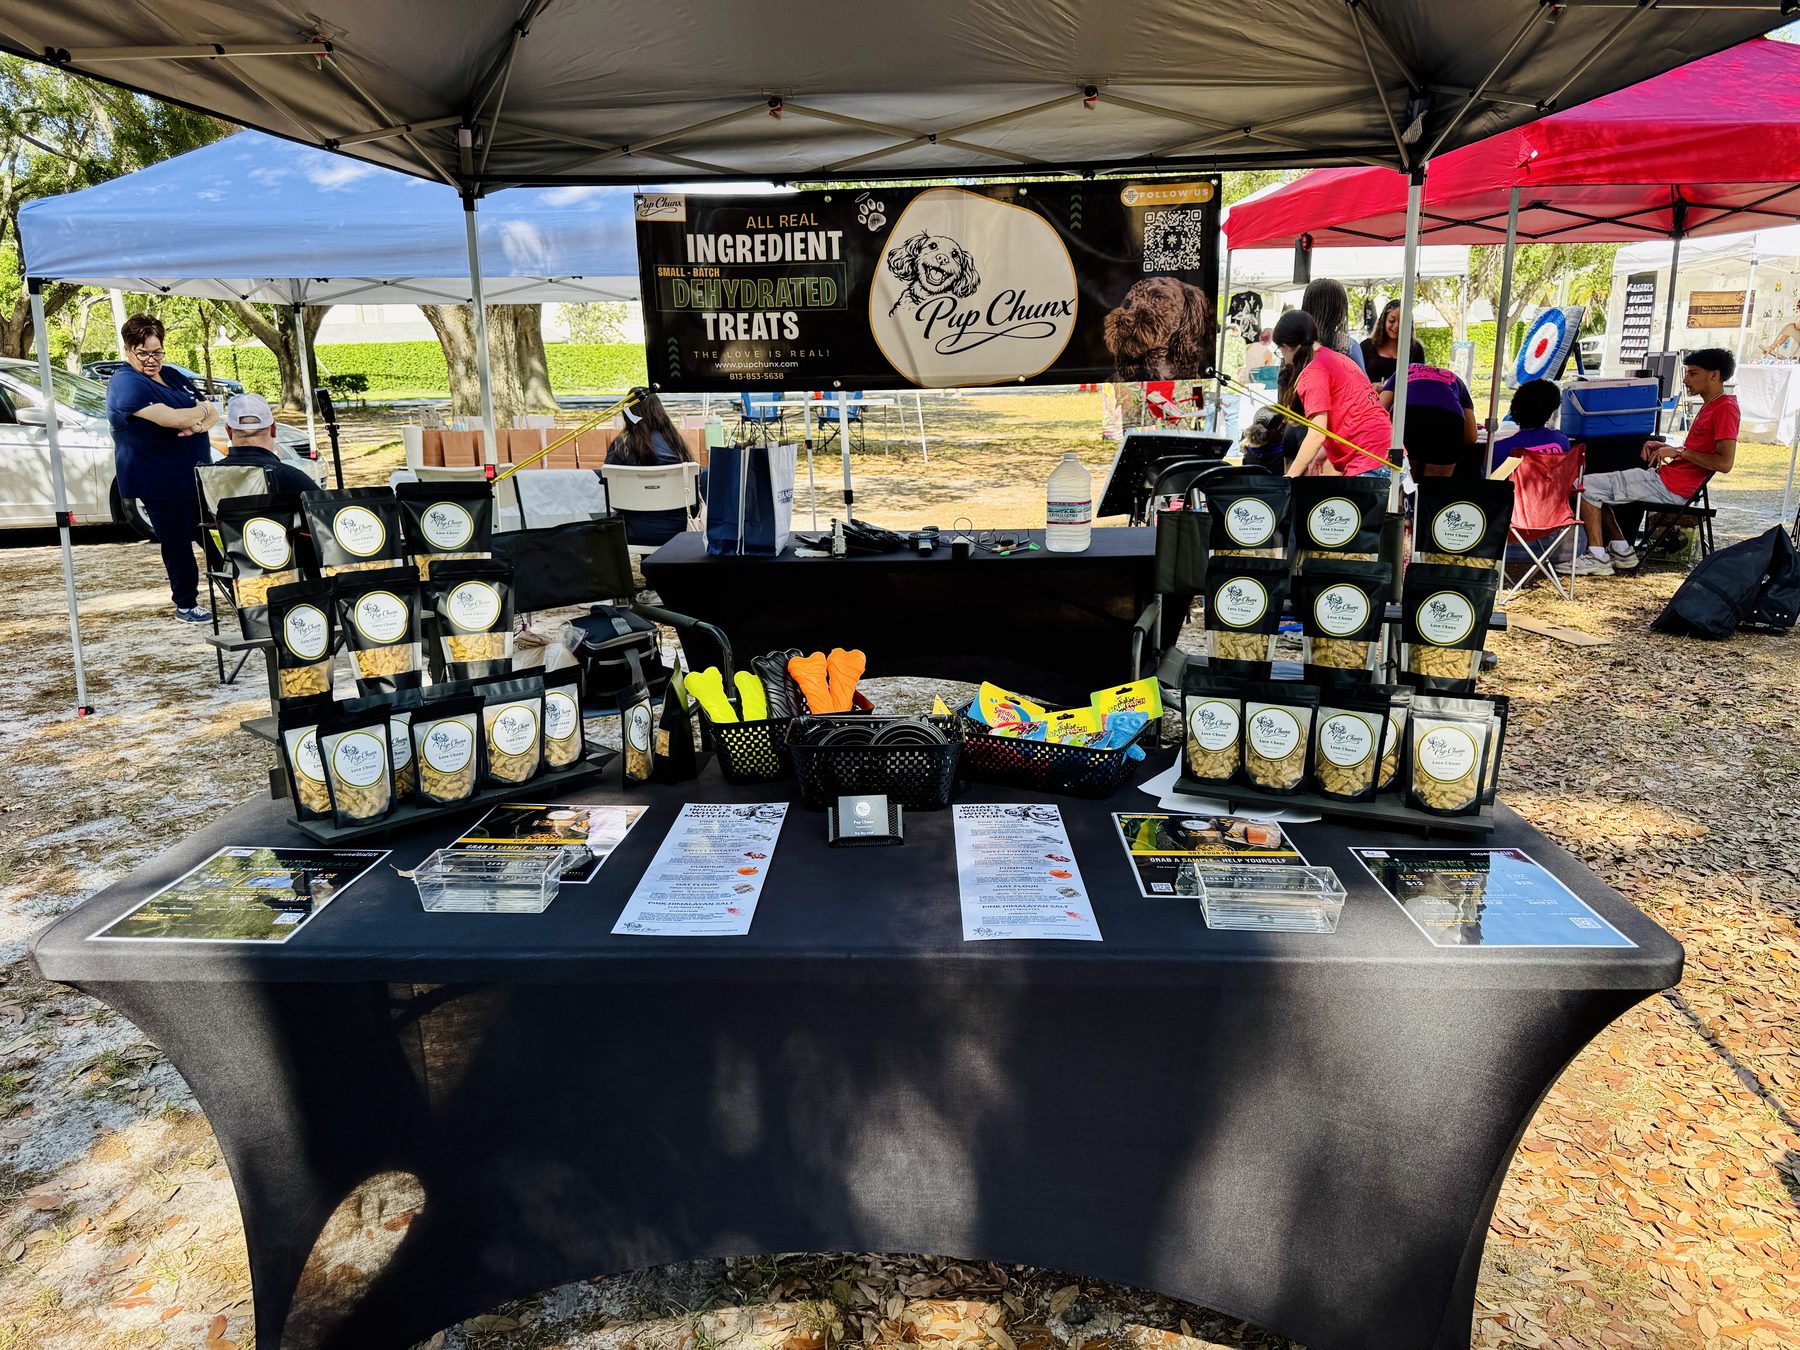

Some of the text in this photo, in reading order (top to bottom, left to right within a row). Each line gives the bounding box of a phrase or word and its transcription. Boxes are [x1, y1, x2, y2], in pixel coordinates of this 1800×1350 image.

[1139, 188, 1209, 199] FOLLOW US
[746, 213, 819, 229] ALL REAL
[686, 230, 843, 263] INGREDIENT
[657, 267, 720, 278] SMALL BATCH
[672, 277, 837, 309] DEHYDRATED
[914, 289, 1076, 348] Pup Chunx
[702, 311, 800, 341] TREATS
[693, 349, 831, 359] THE LOVE IS REAL!
[714, 360, 799, 370] www.pupchunx.com
[729, 372, 784, 380] 813-853-5638
